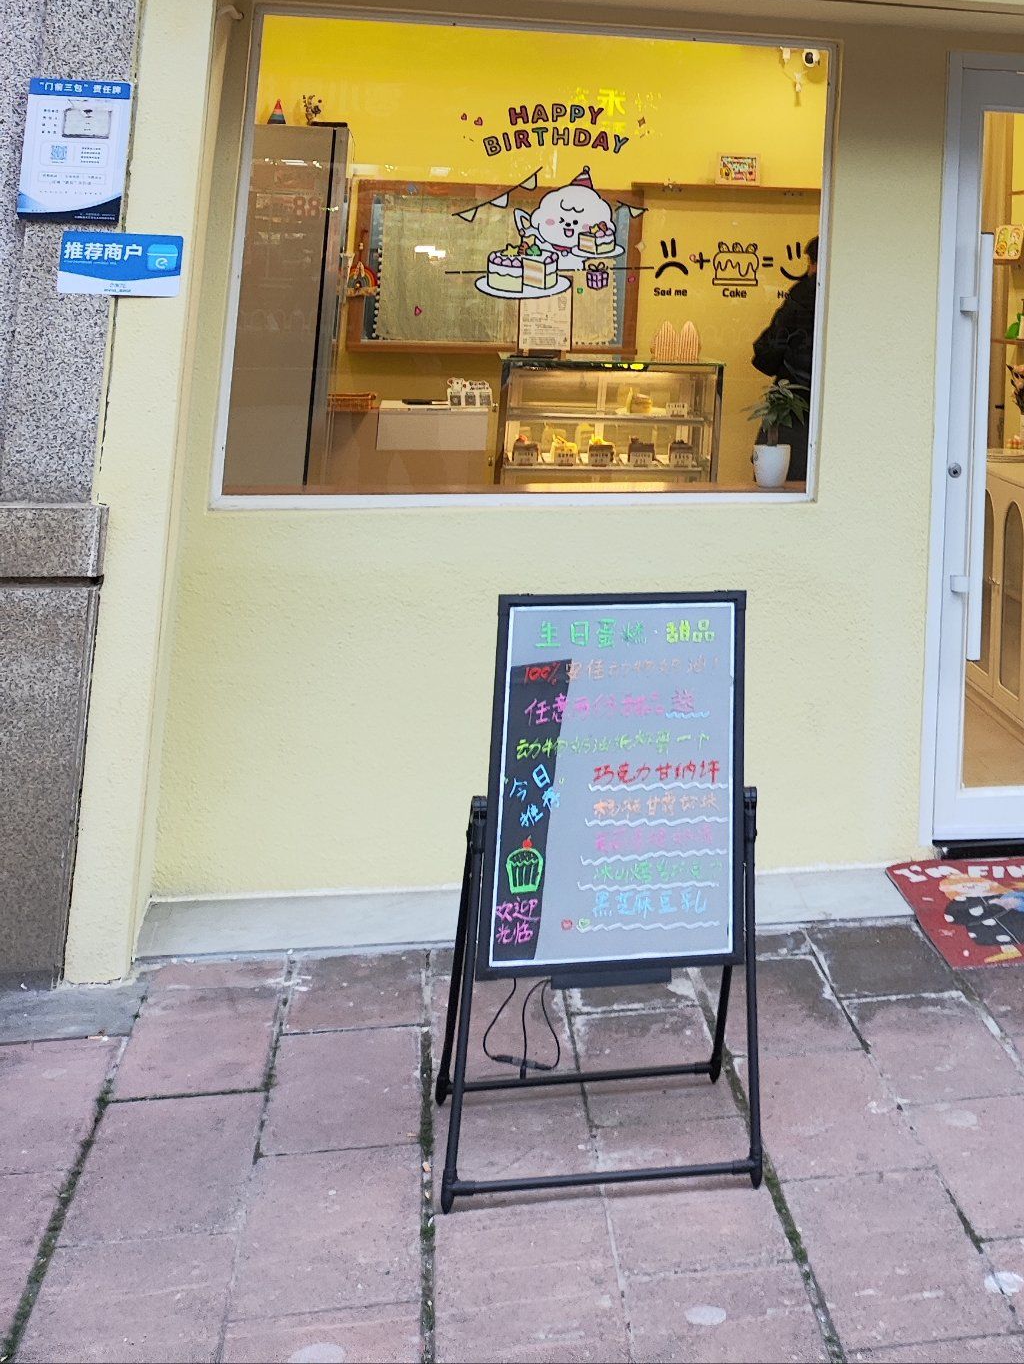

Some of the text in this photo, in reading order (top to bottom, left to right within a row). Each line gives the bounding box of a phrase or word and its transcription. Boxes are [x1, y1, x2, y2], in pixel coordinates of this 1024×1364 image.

[508, 103, 604, 126] HAPPY
[482, 127, 630, 157] BIRTHDAY
[64, 241, 143, 262] 推荐商户
[653, 287, 688, 297] Sad me
[722, 288, 747, 298] Cake
[495, 897, 541, 922] 欢迎
[495, 920, 534, 945] 光临
